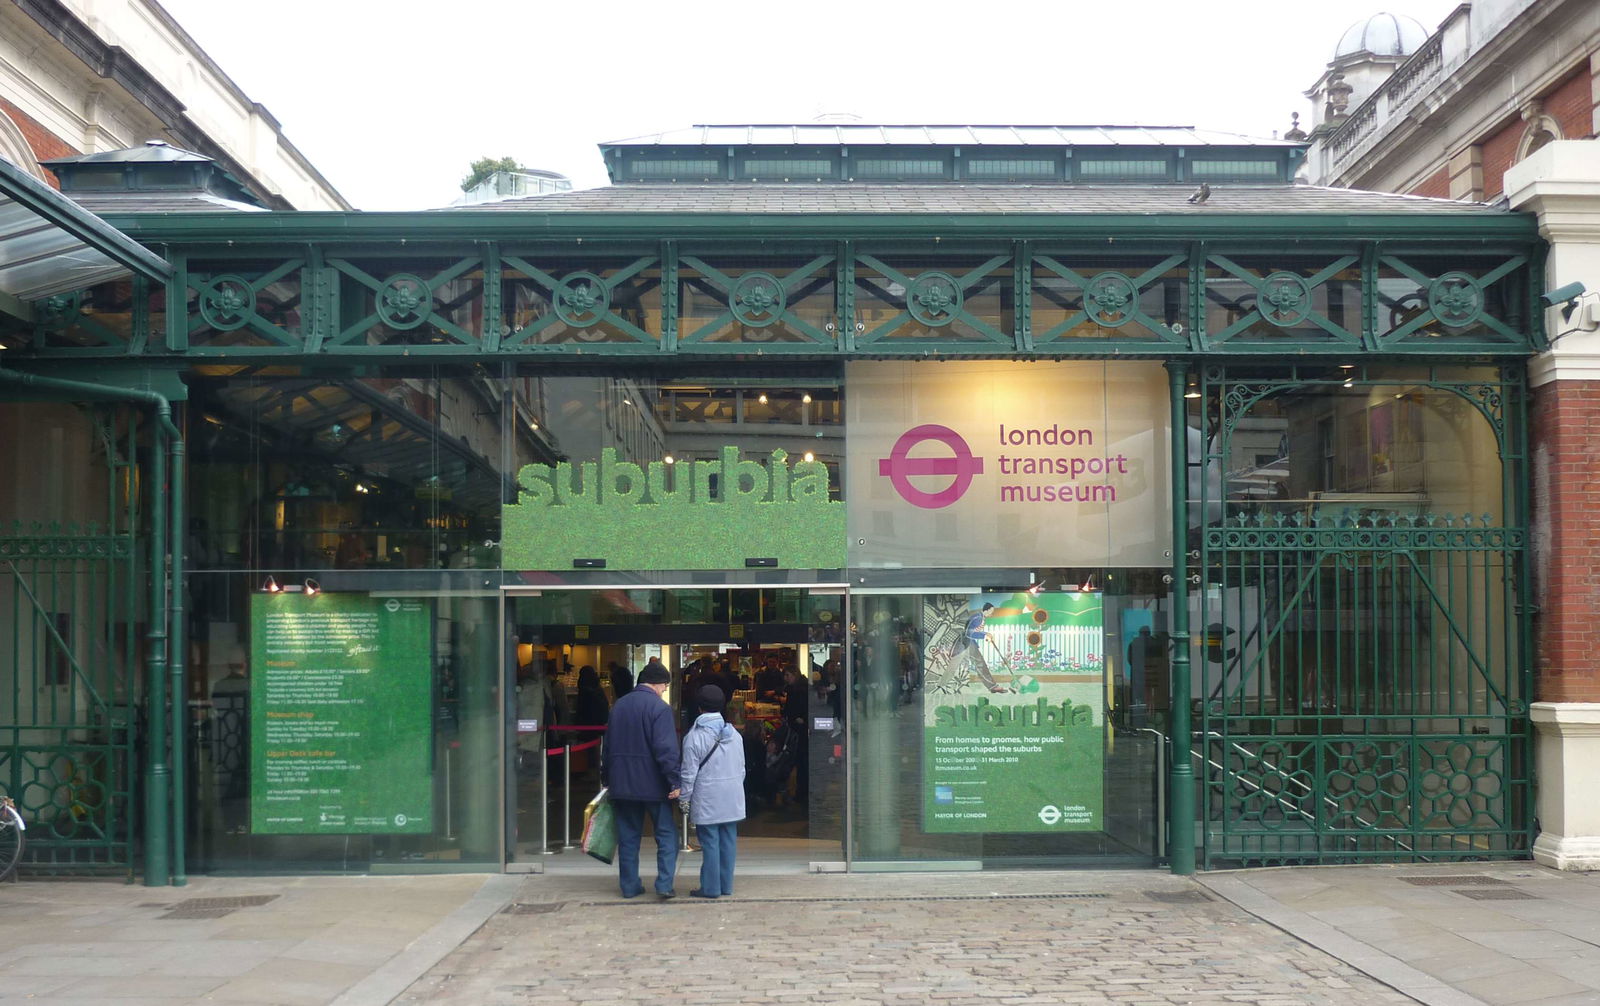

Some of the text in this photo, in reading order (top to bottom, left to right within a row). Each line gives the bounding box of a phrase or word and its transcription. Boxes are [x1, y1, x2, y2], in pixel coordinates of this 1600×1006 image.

[1000, 424, 1092, 445] london
[517, 446, 830, 505] suburbia
[998, 455, 1127, 479] transport
[1001, 486, 1116, 502] museum
[935, 696, 1093, 727] suburbia
[935, 736, 954, 744] From
[956, 736, 980, 744] homes
[982, 736, 990, 744] to
[1024, 735, 1040, 743] how
[1041, 735, 1064, 744] public
[935, 745, 969, 754] transport
[971, 745, 998, 754] shaped
[1063, 811, 1093, 819] transport
